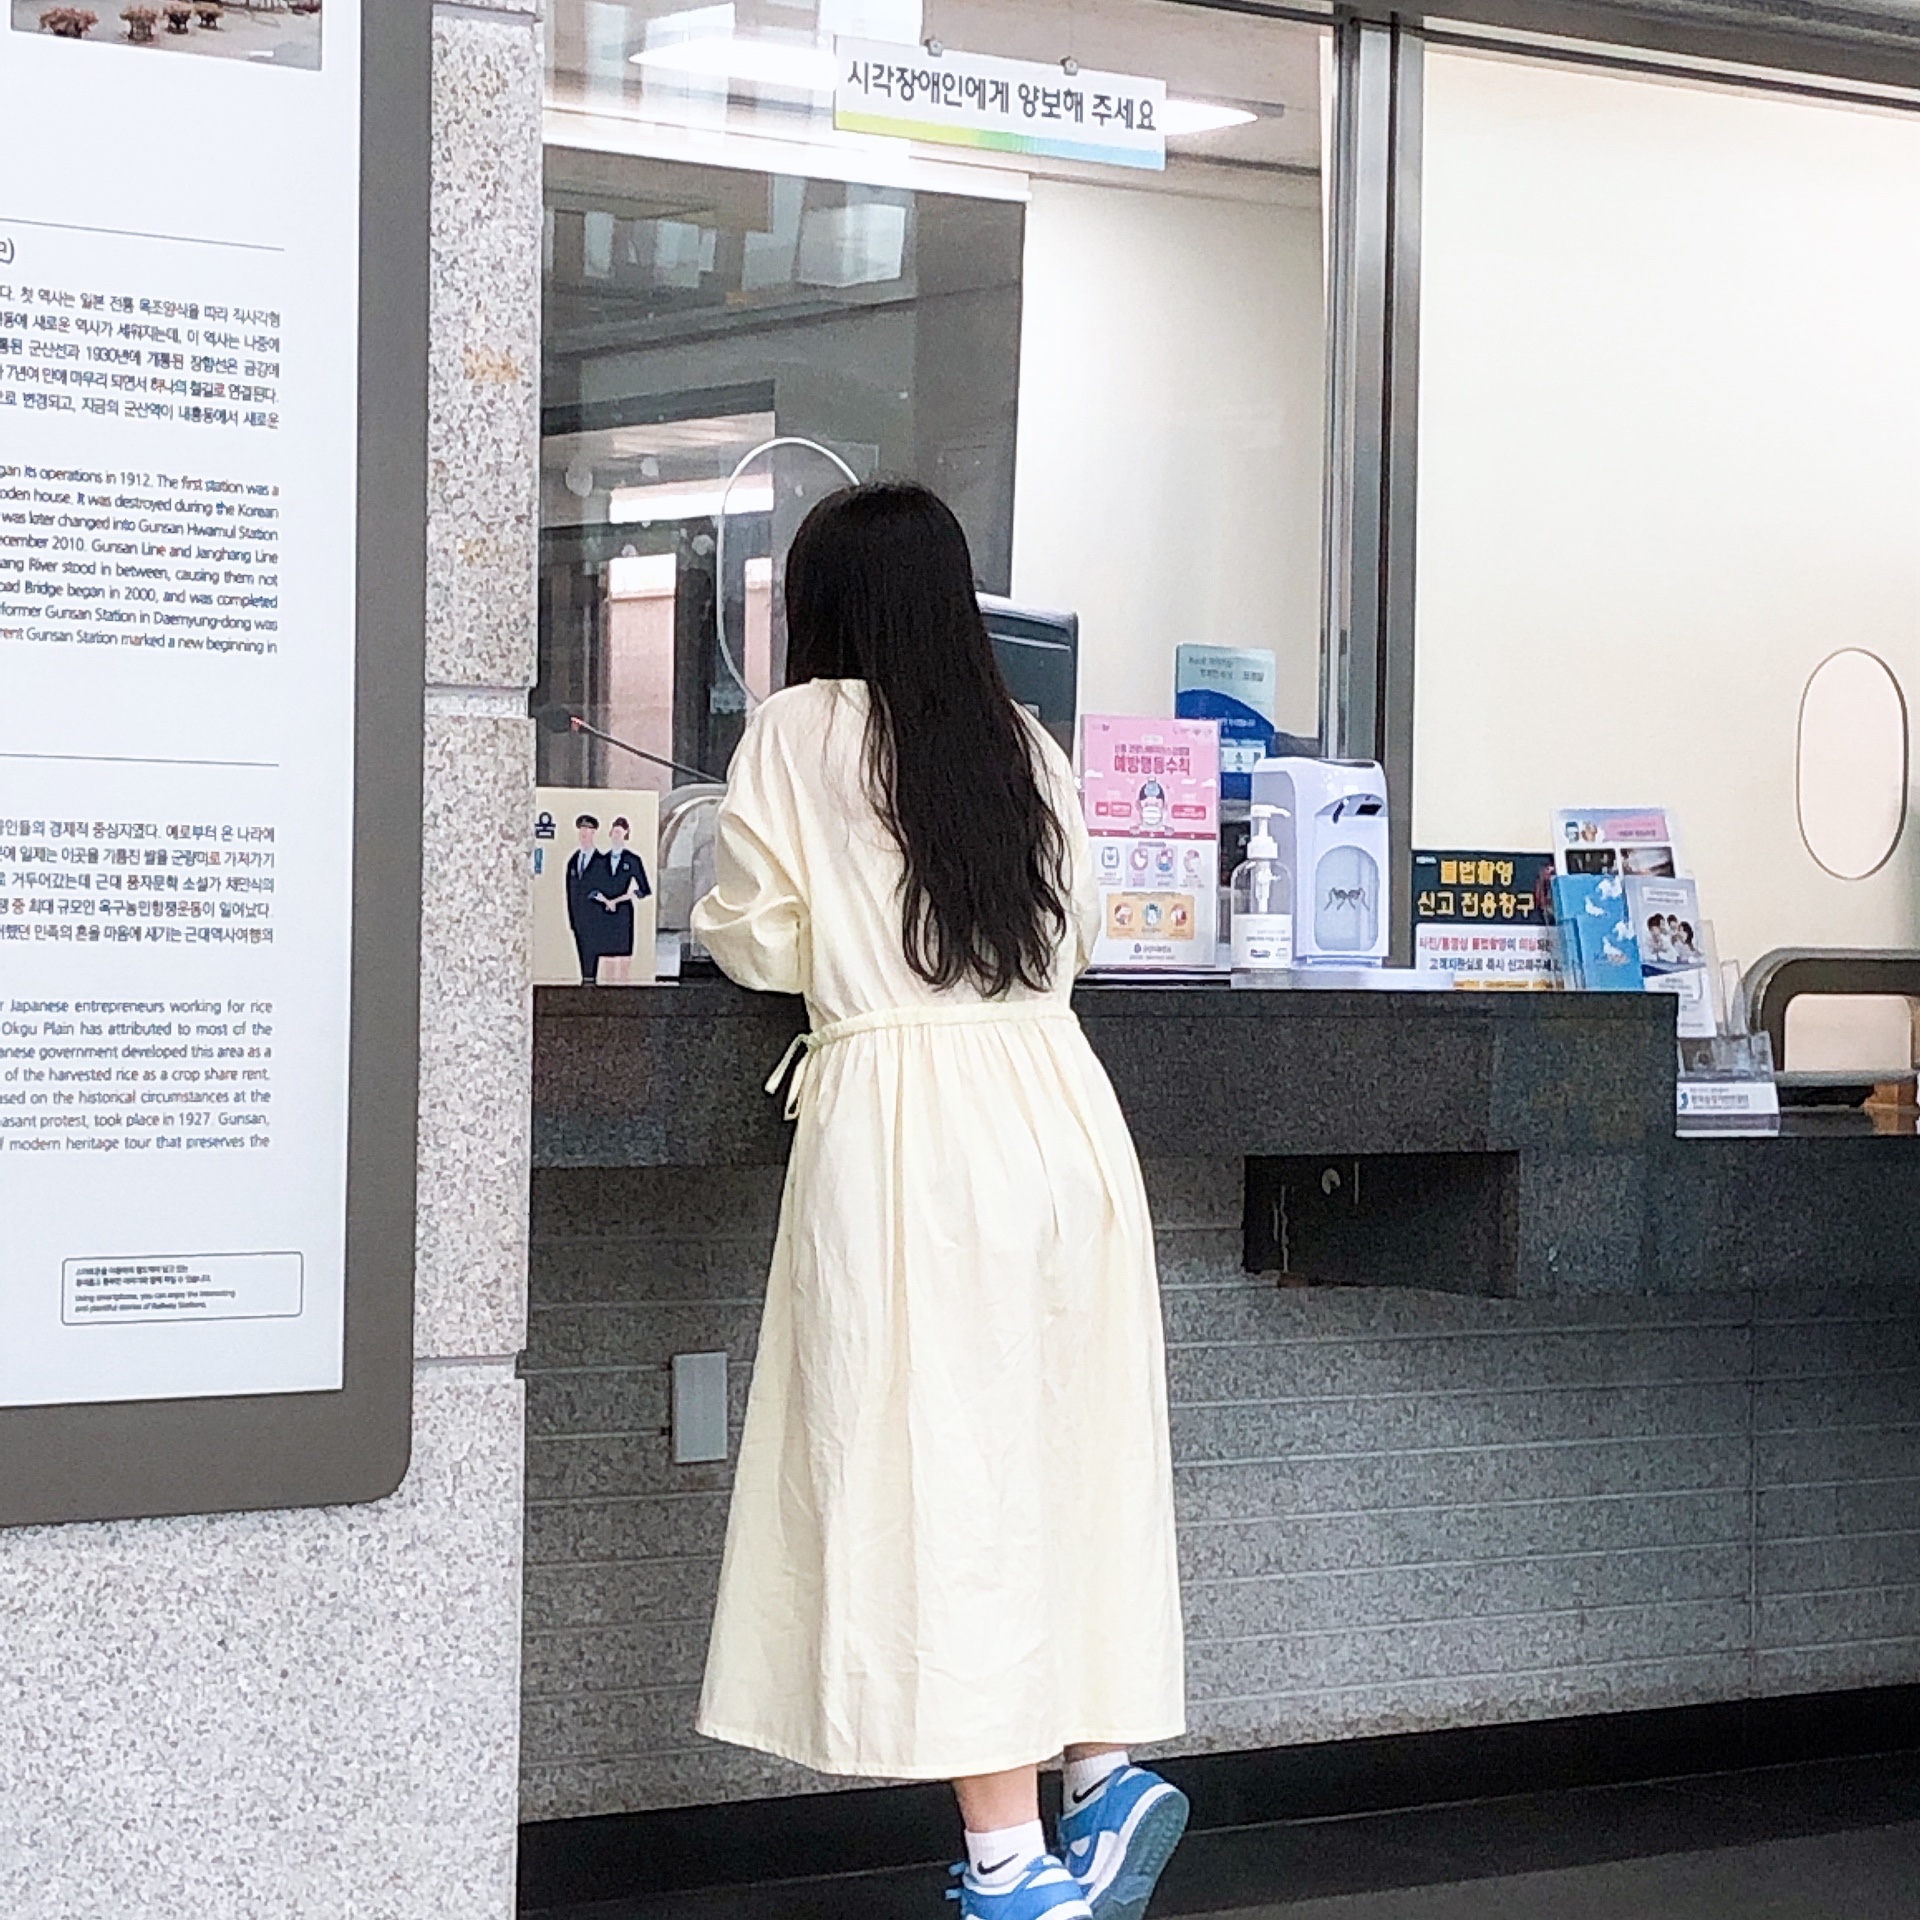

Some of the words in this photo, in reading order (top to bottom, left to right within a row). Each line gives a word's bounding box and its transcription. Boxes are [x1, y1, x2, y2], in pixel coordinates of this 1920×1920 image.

[847, 60, 1009, 114] 시각장애인에게
[1017, 82, 1084, 124] 양보해
[1091, 93, 1157, 131] 주세요
[38, 288, 75, 307] 역사는
[80, 292, 104, 310] 일본
[204, 305, 228, 321] 따라
[232, 308, 280, 327] 직사각형
[74, 318, 113, 336] 역사가
[116, 323, 181, 343] 세워지는데,
[187, 329, 198, 344] 이
[203, 330, 239, 349] 역사는
[244, 335, 279, 352] 나중에
[28, 340, 80, 359] 군산선과
[86, 346, 141, 365] 1930년에
[244, 360, 279, 377] 금강에
[70, 370, 107, 388] 마무리
[111, 374, 146, 391] 되면서
[228, 383, 279, 403] 연결된다.
[22, 392, 75, 411] 변경되고,
[81, 397, 118, 415] 지금의
[124, 400, 173, 419] 군산역이
[24, 465, 37, 478] its
[39, 468, 103, 483] operations
[105, 473, 116, 483] in
[120, 471, 153, 487] 1912.
[156, 473, 178, 488] The
[181, 475, 202, 489] first
[205, 477, 244, 492] station
[246, 484, 269, 495] was
[33, 488, 73, 503] house.
[76, 491, 85, 505] It
[87, 496, 111, 507] was
[114, 495, 171, 511] destroyed
[174, 499, 212, 516] during
[215, 501, 234, 515] the
[237, 504, 278, 518] Korean
[1, 512, 26, 523] was
[28, 510, 55, 525] later
[57, 514, 110, 530] changed
[112, 518, 136, 531] into
[138, 518, 184, 534] Gunsan
[238, 525, 278, 540] Station
[52, 535, 87, 550] 2010.
[91, 538, 138, 553] Gunsan
[141, 542, 166, 556] Line
[169, 545, 191, 558] and
[255, 550, 278, 563] Line
[28, 557, 58, 571] River
[62, 561, 96, 574] stood
[100, 565, 111, 575] in
[116, 563, 171, 580] between,
[175, 569, 219, 584] causing
[224, 570, 254, 583] them
[258, 574, 277, 586] not
[24, 580, 63, 597] Bridge
[66, 583, 105, 599] began
[109, 588, 120, 598] in
[124, 586, 158, 602] 2000,
[162, 590, 185, 603] and
[189, 594, 213, 604] was
[216, 594, 277, 608] completed
[45, 604, 92, 619] Gunsan
[94, 607, 136, 622] Station
[139, 612, 150, 623] in
[254, 620, 277, 631] was
[26, 627, 73, 641] Gunsan
[76, 629, 118, 644] Station
[121, 633, 165, 647] marked
[178, 637, 204, 648] new
[206, 637, 264, 654] beginning
[267, 642, 277, 652] in
[166, 824, 216, 840] 예로부터
[19, 846, 57, 862] 일제는
[103, 848, 140, 865] 기름진
[224, 851, 274, 867] 가져가기
[95, 873, 121, 890] 근대
[126, 874, 178, 891] 풍자문학
[182, 876, 221, 892] 소설가
[1440, 860, 1514, 886] 불법촬영
[56, 898, 95, 915] 규모인
[1417, 890, 1455, 917] 신고
[1461, 891, 1535, 918] 전용창구
[34, 924, 72, 940] 민족의
[75, 924, 100, 941] 혼을
[103, 924, 141, 941] 마음에
[10, 1000, 68, 1012] Japanese
[74, 1000, 164, 1013] entrepreneurs
[169, 1000, 221, 1014] working
[227, 999, 244, 1013] for
[250, 1002, 272, 1013] rice
[1, 1021, 37, 1037] Okgu
[43, 1021, 74, 1035] Plain
[80, 1021, 102, 1035] has
[108, 1021, 171, 1035] attributed
[177, 1023, 191, 1035] to
[196, 1023, 227, 1035] most
[232, 1021, 246, 1035] of
[252, 1022, 272, 1035] the
[38, 1047, 118, 1060] government
[121, 1044, 187, 1058] developed
[190, 1046, 214, 1057] this
[217, 1046, 244, 1057] area
[247, 1046, 261, 1057] as
[4, 1066, 18, 1081] of
[23, 1068, 44, 1081] the
[48, 1068, 111, 1081] harvested
[116, 1070, 138, 1080] rice
[142, 1070, 156, 1080] as
[171, 1070, 200, 1082] crop
[204, 1067, 238, 1080] share
[242, 1068, 269, 1080] rent.
[30, 1093, 47, 1104] on
[52, 1090, 74, 1104] the
[78, 1090, 136, 1103] historical
[140, 1091, 229, 1103] circumstances
[233, 1090, 246, 1102] at
[250, 1089, 270, 1102] the
[40, 1115, 88, 1128] protest,
[94, 1113, 122, 1126] took
[126, 1113, 159, 1127] place
[162, 1115, 174, 1125] in
[179, 1111, 213, 1125] 1927.
[218, 1112, 269, 1125] Gunsan,
[9, 1138, 60, 1150] modern
[66, 1137, 119, 1151] heritage
[124, 1136, 151, 1148] tour
[156, 1136, 181, 1148] that
[186, 1136, 244, 1148] preserves
[250, 1134, 269, 1147] the
